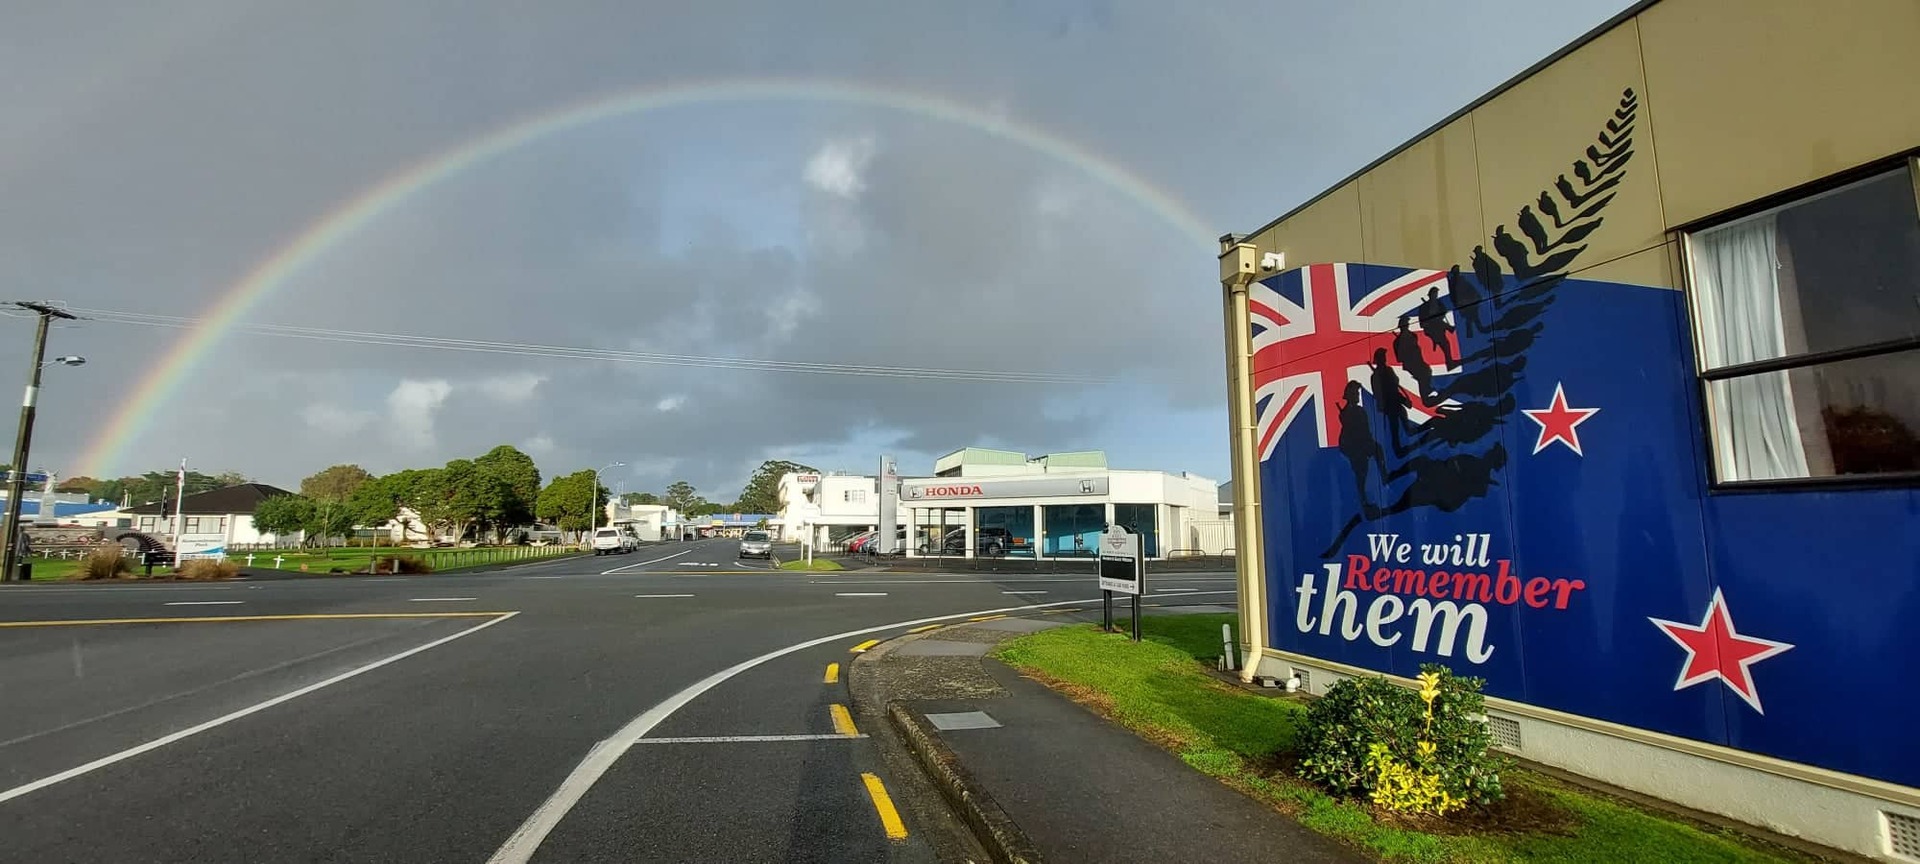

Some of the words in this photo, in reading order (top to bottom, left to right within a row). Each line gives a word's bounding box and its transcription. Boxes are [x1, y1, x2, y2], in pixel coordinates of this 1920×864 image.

[925, 485, 983, 497] HONDA
[1367, 534, 1410, 563] We
[1421, 533, 1490, 567] will
[1344, 555, 1585, 609] Remember
[1296, 564, 1494, 664] them
